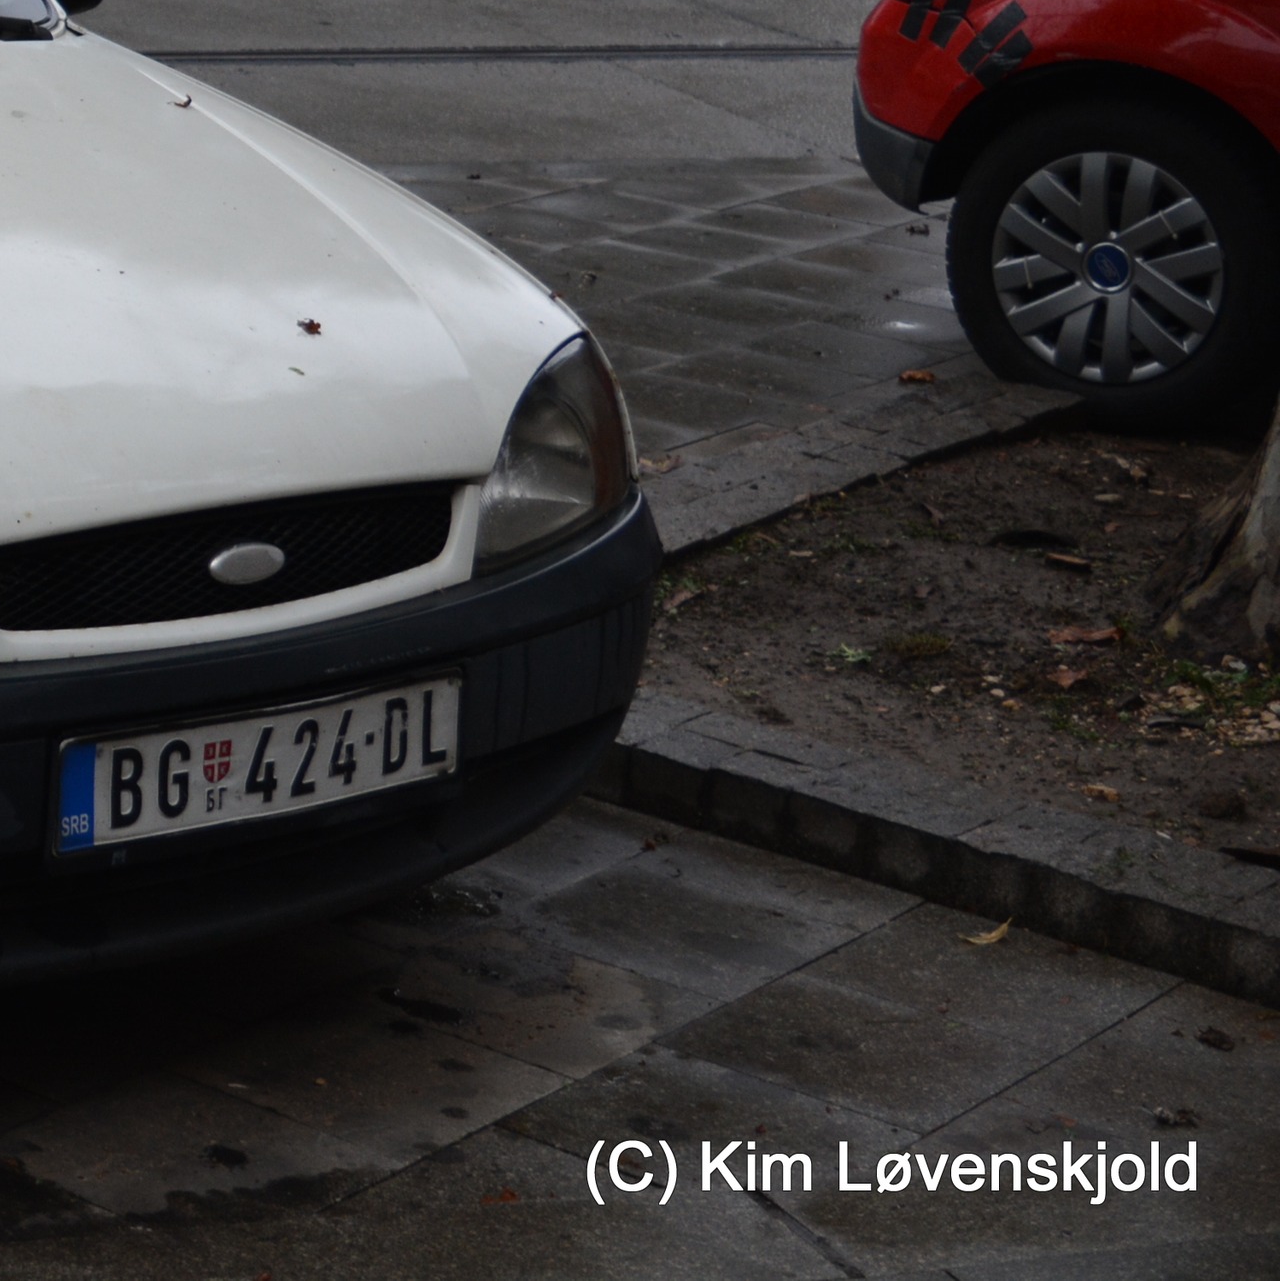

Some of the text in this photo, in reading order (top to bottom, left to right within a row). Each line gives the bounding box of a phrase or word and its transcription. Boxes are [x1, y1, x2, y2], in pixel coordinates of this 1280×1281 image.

[110, 738, 191, 830] BG
[206, 787, 228, 812] БГ
[60, 813, 90, 837] SRB
